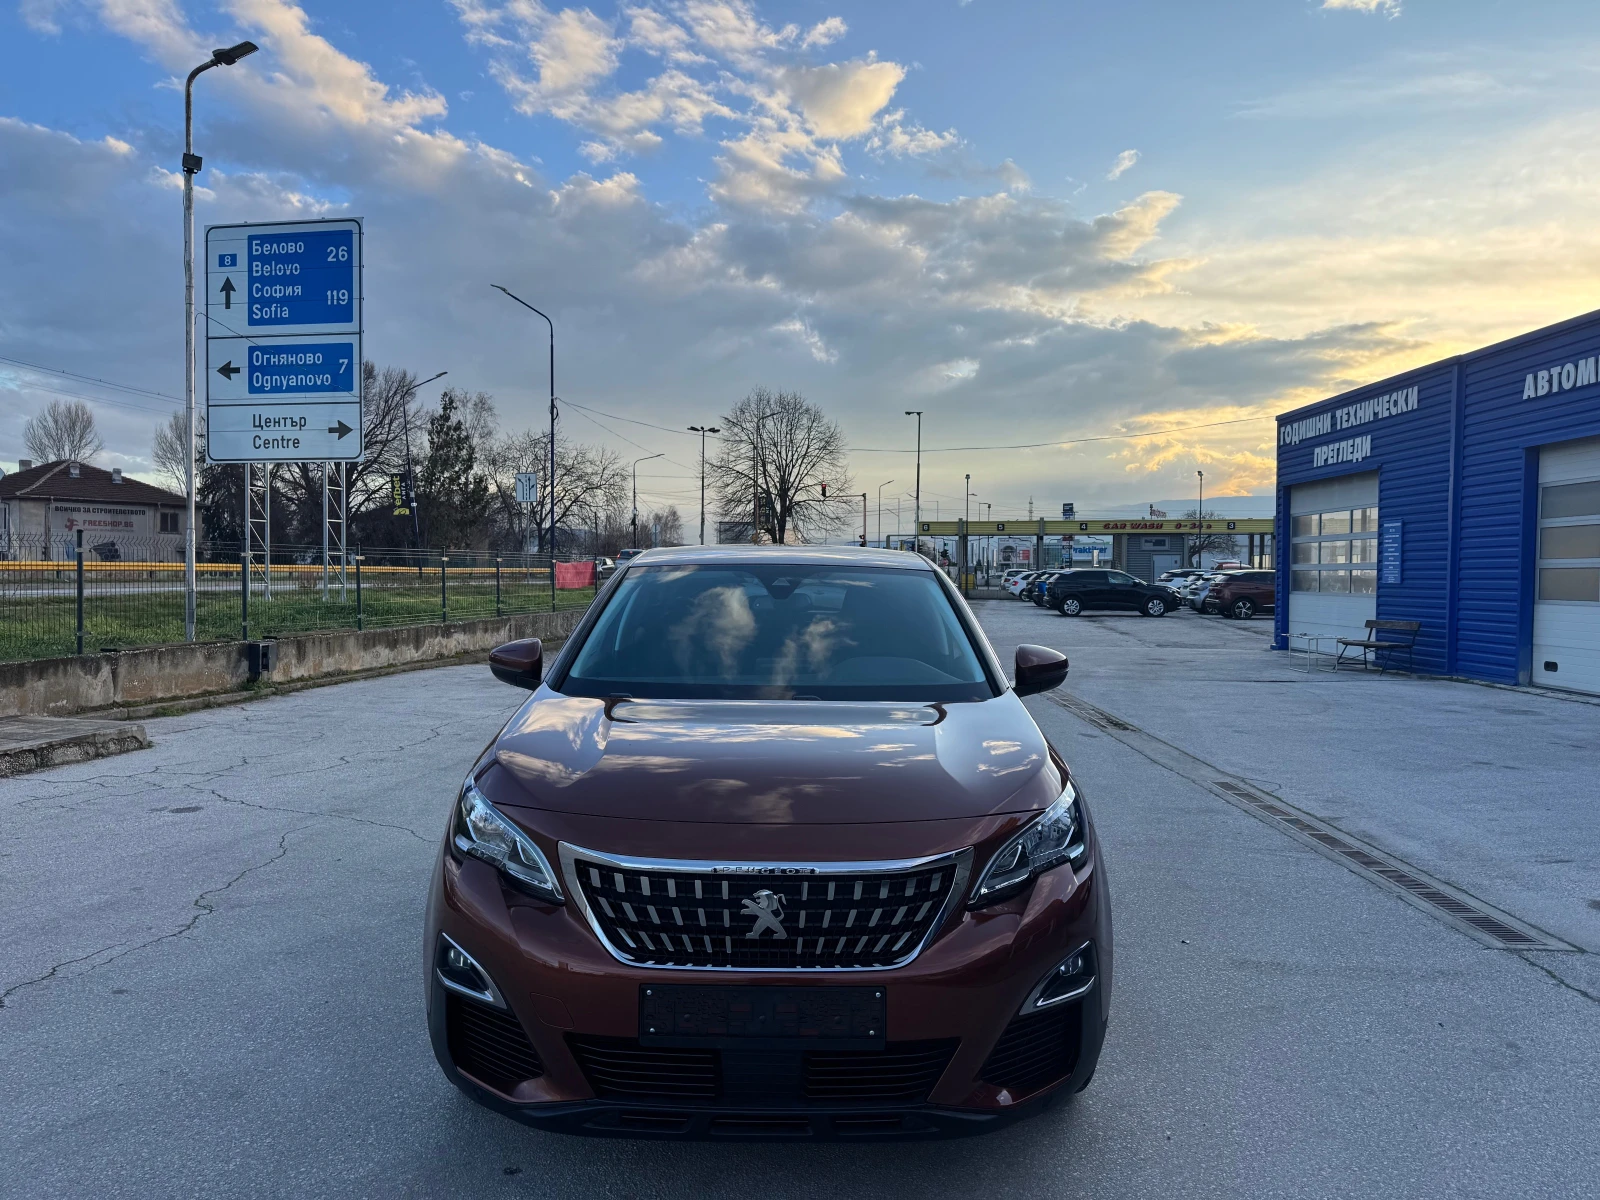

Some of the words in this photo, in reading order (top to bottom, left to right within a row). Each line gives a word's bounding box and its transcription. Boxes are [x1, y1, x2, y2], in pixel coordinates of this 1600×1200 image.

[252, 240, 304, 256] Белово
[327, 246, 348, 262] 26
[224, 255, 232, 266] 8
[252, 261, 300, 277] Belovo
[252, 283, 302, 299] София
[326, 289, 349, 306] 119
[252, 303, 289, 319] Sofia
[252, 351, 323, 367] Огняново
[338, 358, 349, 374] 7
[252, 373, 331, 391] Ognyanovo
[1522, 354, 1600, 400] АВТОМ
[252, 413, 307, 431] Център
[1279, 412, 1332, 446] ГОДИШНИ
[1335, 386, 1419, 431] ТЕХНИЧЕСКИ
[252, 435, 300, 450] Centre
[1313, 434, 1372, 468] ПРЕГЛЕДИ
[393, 476, 401, 506] efbet
[92, 507, 146, 515] СТРОИТЕЛСТВОТО
[82, 519, 134, 528] FREESHOP.BG
[1103, 522, 1127, 530] CAR
[1130, 522, 1164, 530] WASH
